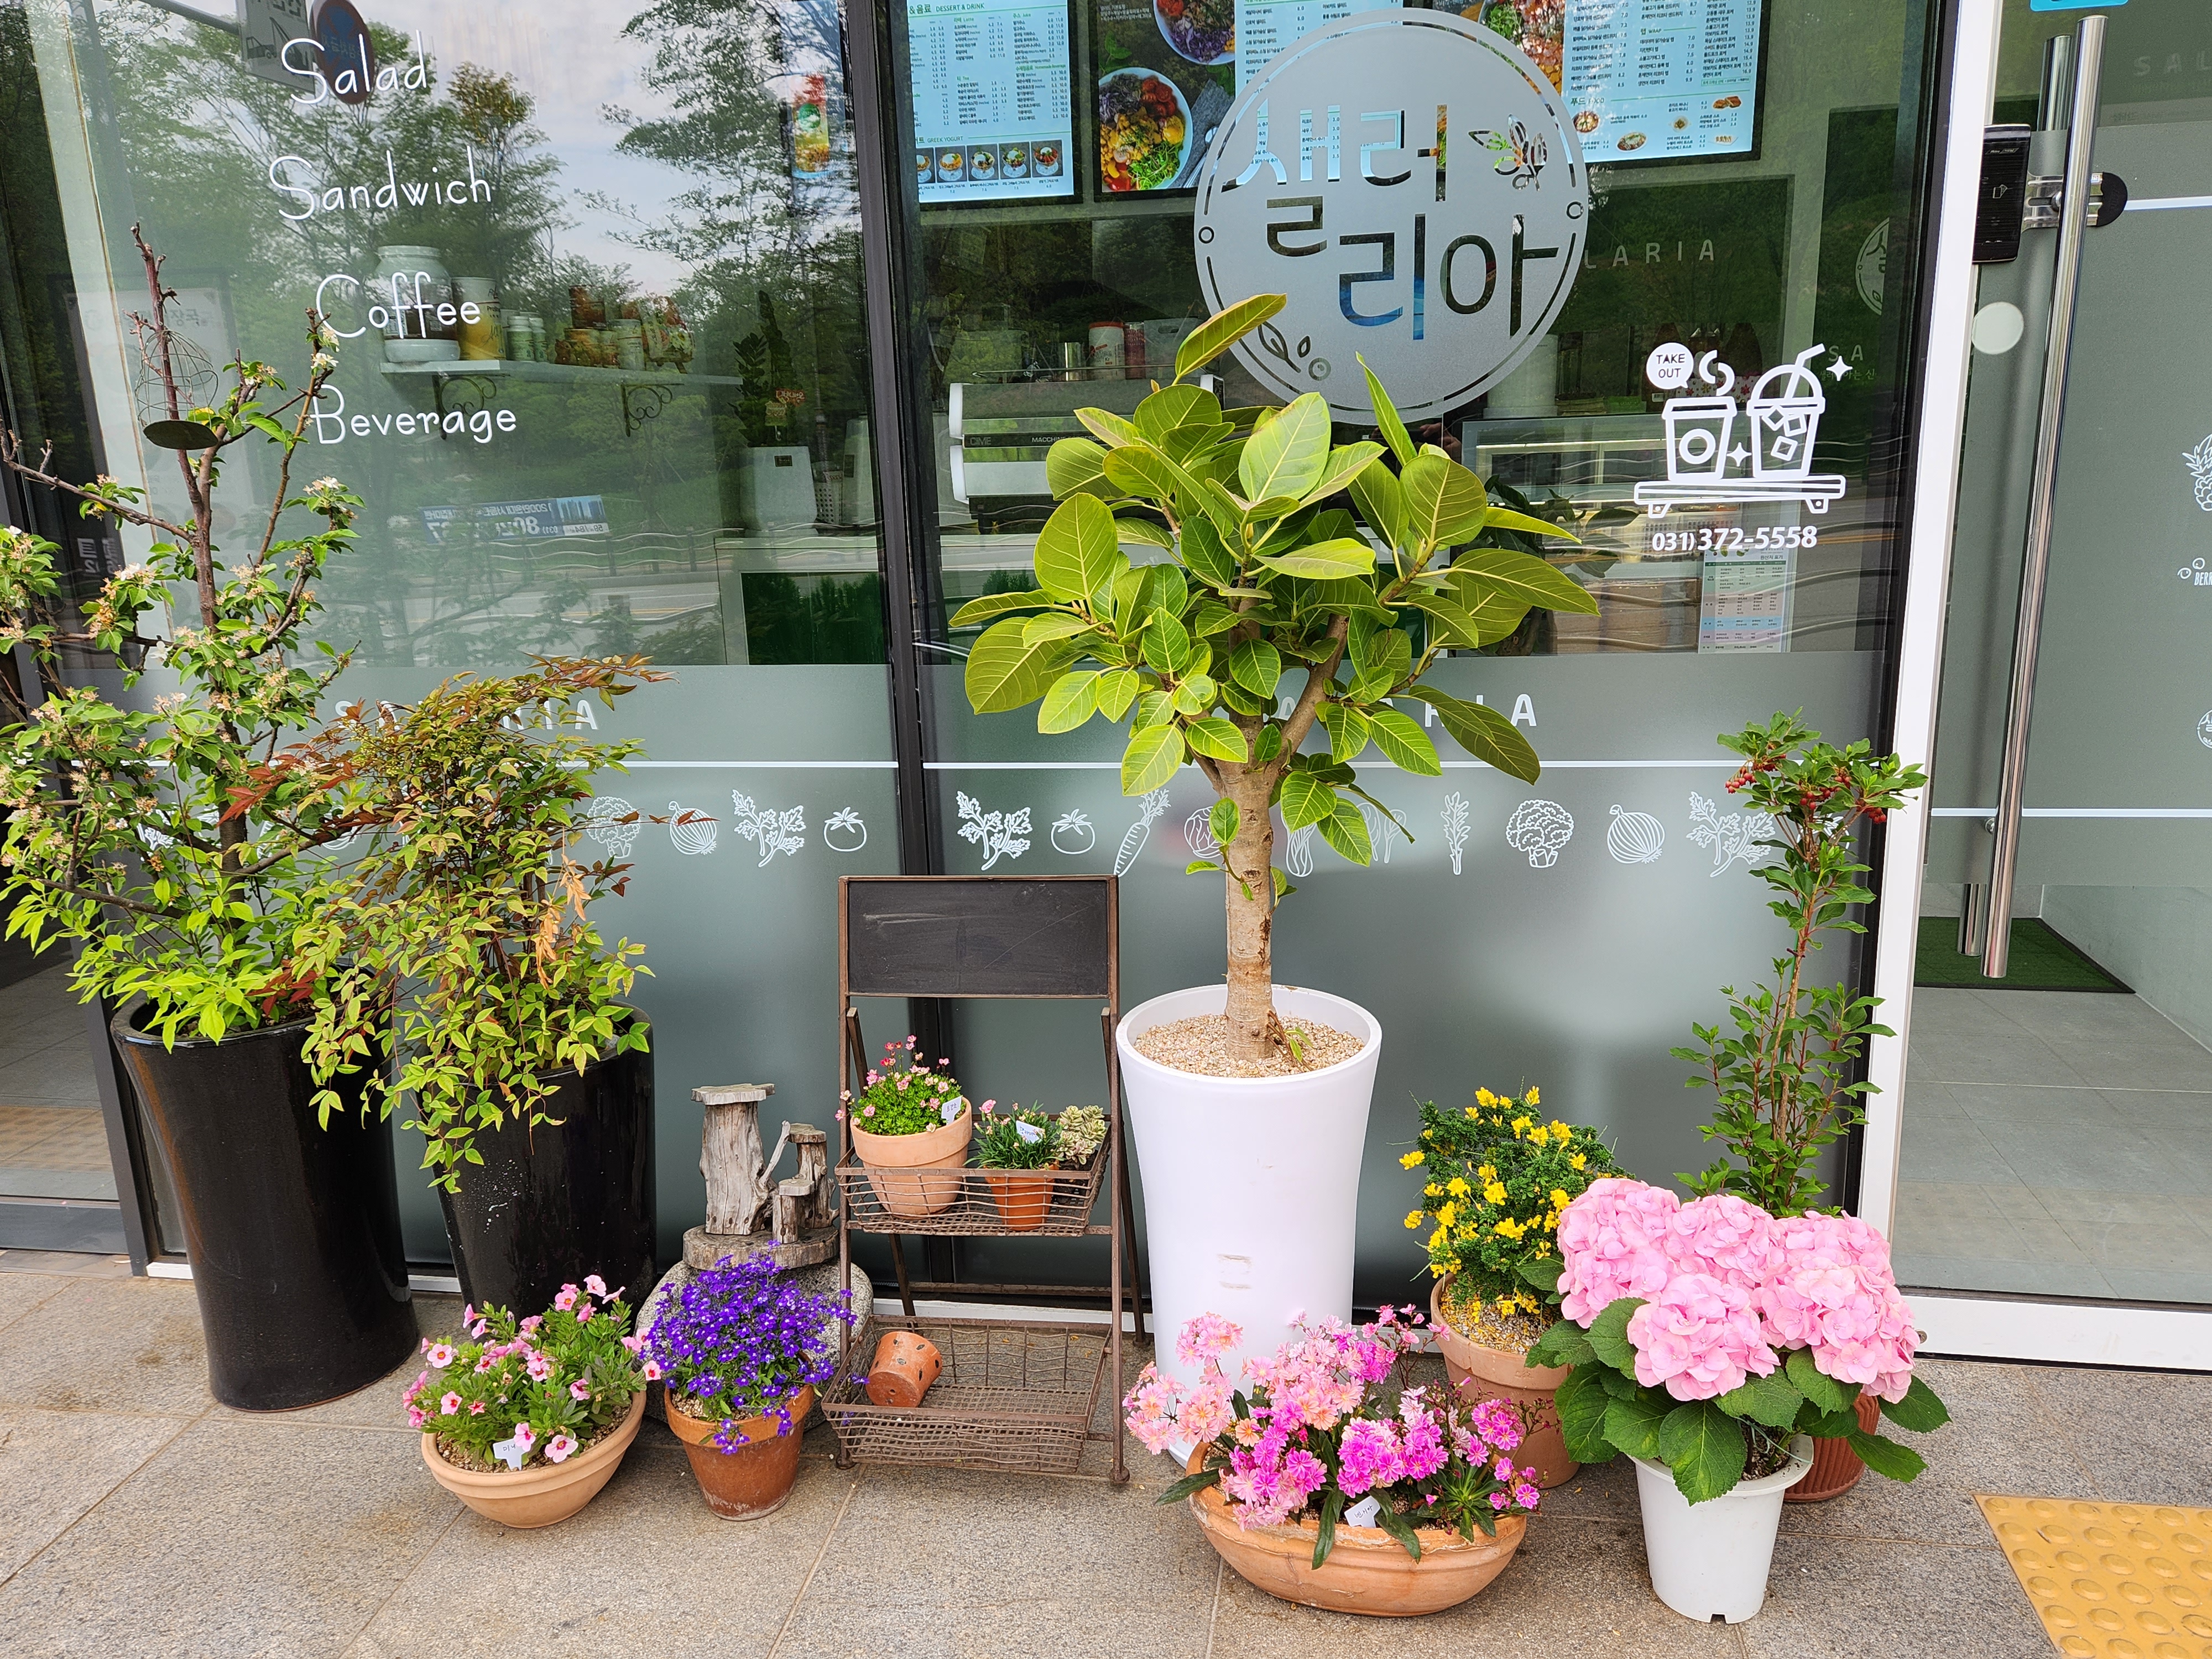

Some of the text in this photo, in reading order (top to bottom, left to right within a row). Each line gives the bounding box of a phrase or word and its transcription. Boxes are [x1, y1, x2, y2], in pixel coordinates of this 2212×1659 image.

[936, 4, 961, 12] DESSERT
[281, 30, 426, 104] Salad
[1571, 97, 1586, 106] 푸드
[269, 145, 491, 220] Sandwich
[316, 271, 481, 339] Coffee
[1656, 353, 1686, 364] TAKE
[1658, 368, 1682, 378] OUT
[310, 384, 517, 444] Beverage
